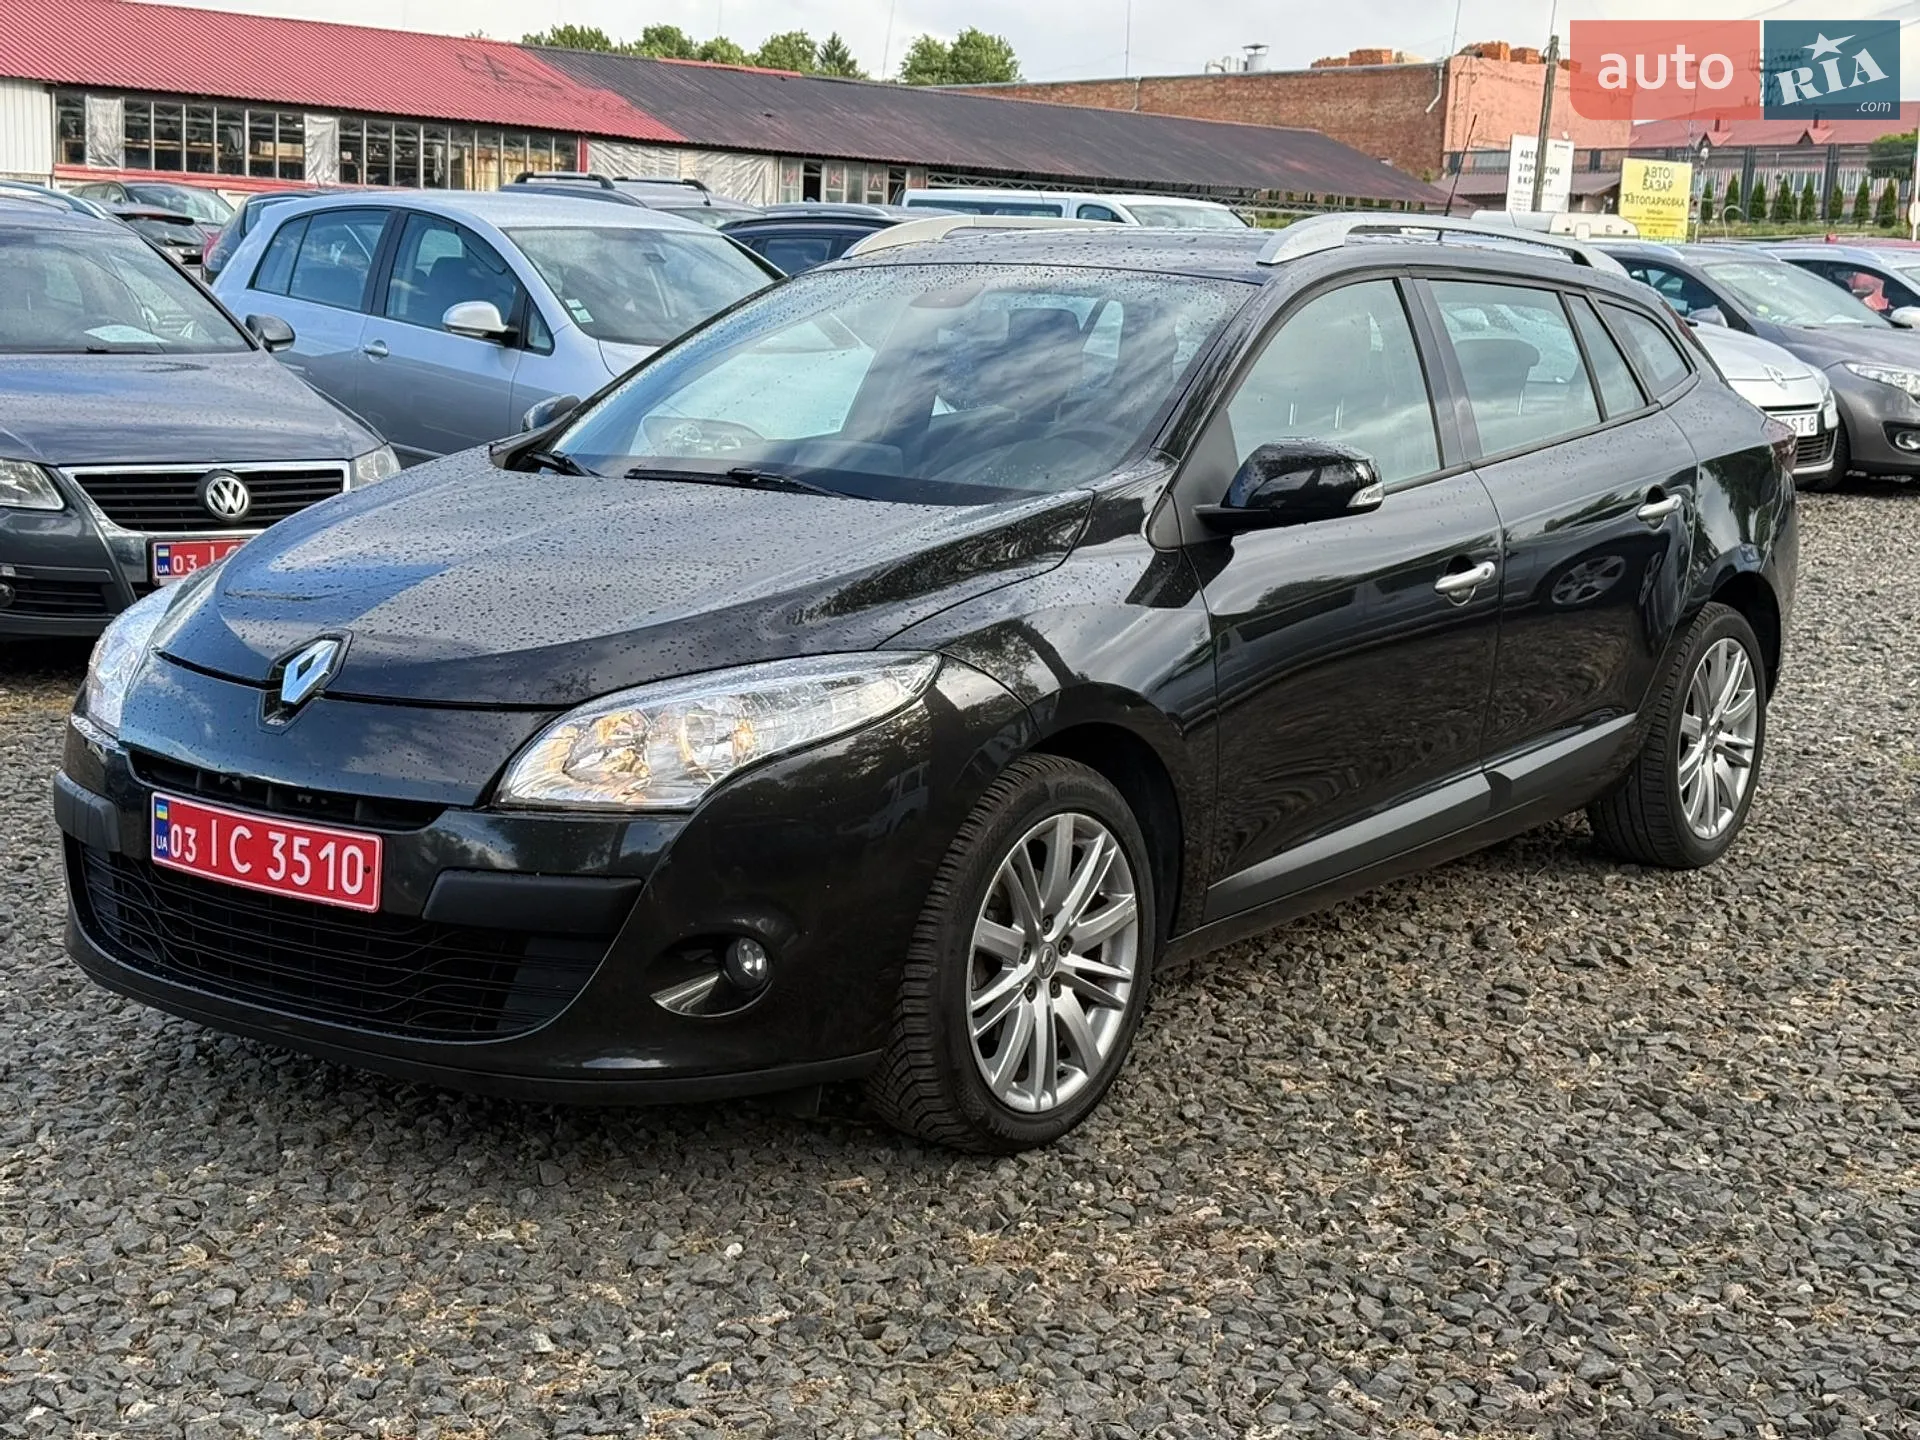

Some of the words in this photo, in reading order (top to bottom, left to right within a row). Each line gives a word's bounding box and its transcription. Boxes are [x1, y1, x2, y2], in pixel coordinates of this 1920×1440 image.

[1643, 165, 1671, 179] АВТО
[1642, 178, 1673, 192] БАЗАР
[157, 564, 170, 574] UA
[173, 554, 198, 573] 03
[156, 835, 168, 851] UA
[170, 824, 197, 863] 03
[267, 831, 364, 895] 3510
